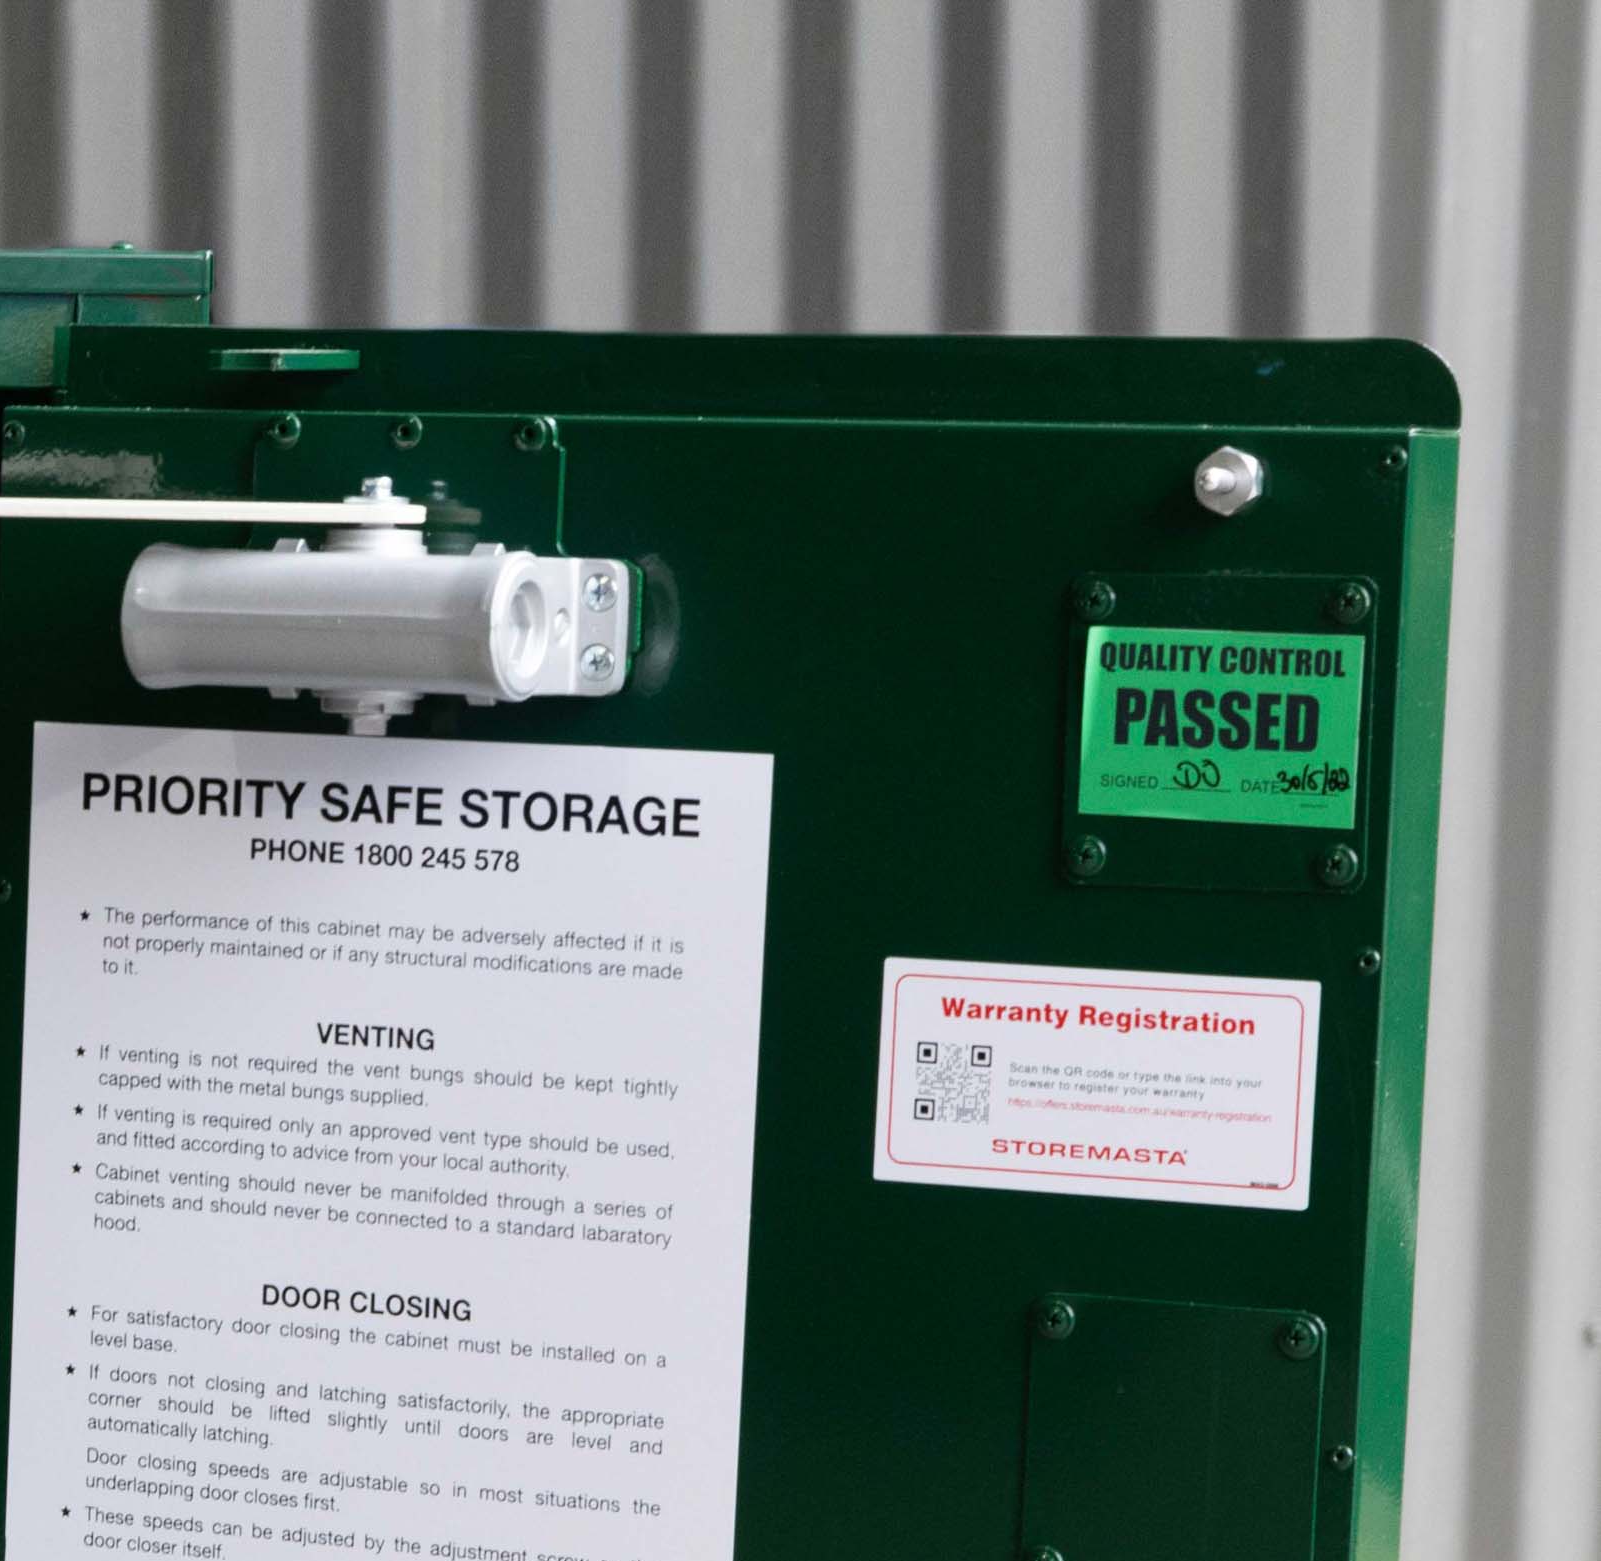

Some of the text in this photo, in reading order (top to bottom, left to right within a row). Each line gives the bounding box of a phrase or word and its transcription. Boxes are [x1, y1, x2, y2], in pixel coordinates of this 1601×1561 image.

[1100, 641, 1345, 677] QUALITY CONTROL
[1114, 687, 1319, 752] PASSED
[1099, 773, 1159, 789] SIGNED
[1240, 779, 1279, 795] DATE
[81, 772, 702, 838] PRIORITY SAFE STORAGE
[249, 836, 520, 873] PHONE 1800 245 578
[102, 905, 684, 955] The performance of this cabinet may be adversely affected if it is
[101, 932, 684, 980] not properly maintained or if any structural modifications are made
[101, 957, 138, 976] to it.
[941, 996, 1255, 1035] Warranty Registration
[315, 1021, 435, 1052] VENTING
[97, 1071, 428, 1108] capped with the metal bungs supplied.
[98, 1043, 679, 1101] If venting is not required the vent bungs should be kept tightly
[1007, 1076, 1205, 1102] browser to register your warranty
[1008, 1060, 1262, 1089] Scan the QR code or type the link into your
[93, 1212, 141, 1233] hood.
[261, 1282, 472, 1323] DOOR CLOSING
[89, 1328, 177, 1353] level base.
[90, 1303, 667, 1369] For satisfactory door closing the cabinet must be installed on a
[86, 1415, 273, 1450] automatically latching.
[84, 1473, 340, 1513] underlapping door closes first.
[82, 1530, 226, 1561] door closer itself.
[83, 1504, 135, 1527] These
[141, 1514, 204, 1534] speeds
[211, 1521, 243, 1537] can
[250, 1521, 273, 1541] be
[280, 1526, 355, 1549] adjusted
[363, 1533, 386, 1555] by
[393, 1535, 422, 1555] the
